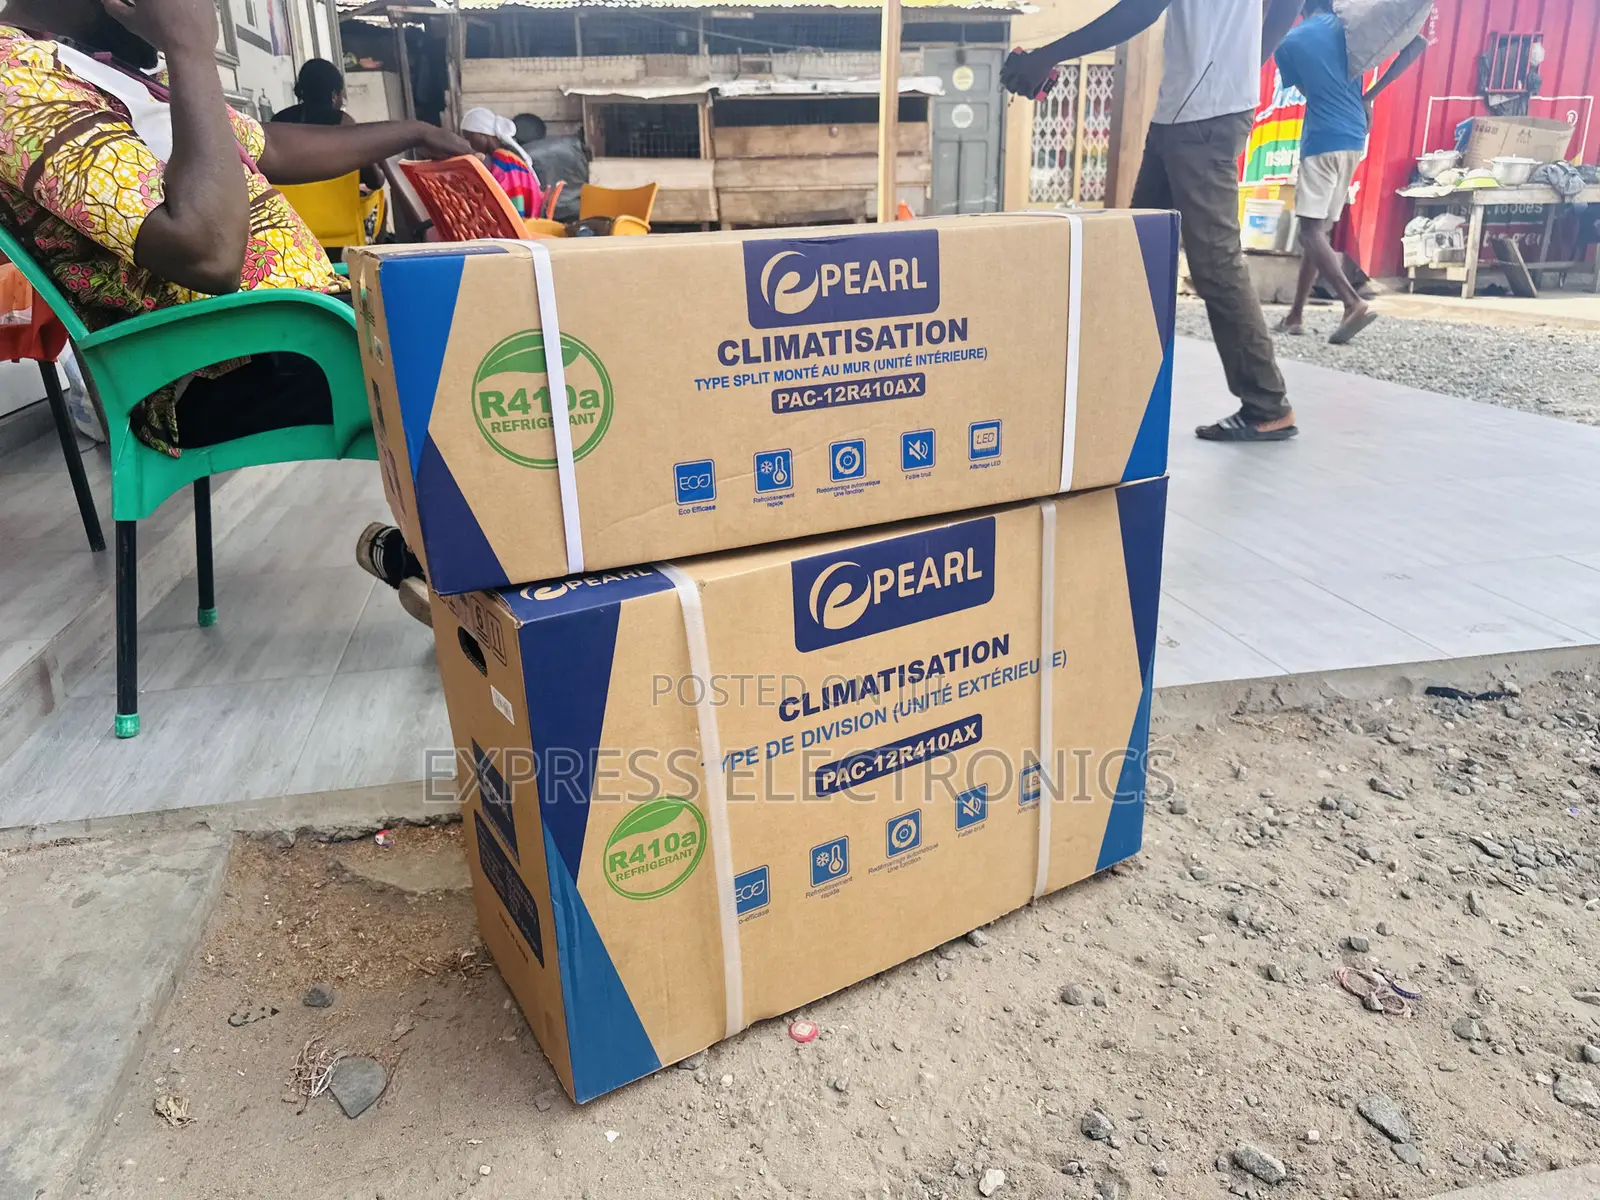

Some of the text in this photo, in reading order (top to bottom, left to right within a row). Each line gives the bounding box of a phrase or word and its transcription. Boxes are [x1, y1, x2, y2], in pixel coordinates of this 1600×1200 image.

[718, 317, 968, 367] CLIMATISATION
[694, 347, 988, 391] TYPE SPLIT MONTÉ AU MUR (UNITÉ INTÉRIEURE)
[777, 376, 921, 410] PAC-12R410AX
[490, 412, 596, 434] REFRIGEANT
[976, 432, 995, 444] LED
[678, 504, 716, 516] Eco Efficase
[778, 633, 1010, 722] CLIMATISATION
[766, 735, 795, 760] DE
[801, 706, 887, 748] DIVISION
[958, 650, 1068, 698] EXTÉRIEUE)
[822, 722, 978, 790] PAC-12R410AX
[608, 830, 697, 874] R410a
[615, 848, 694, 882] REFRIGERANT
